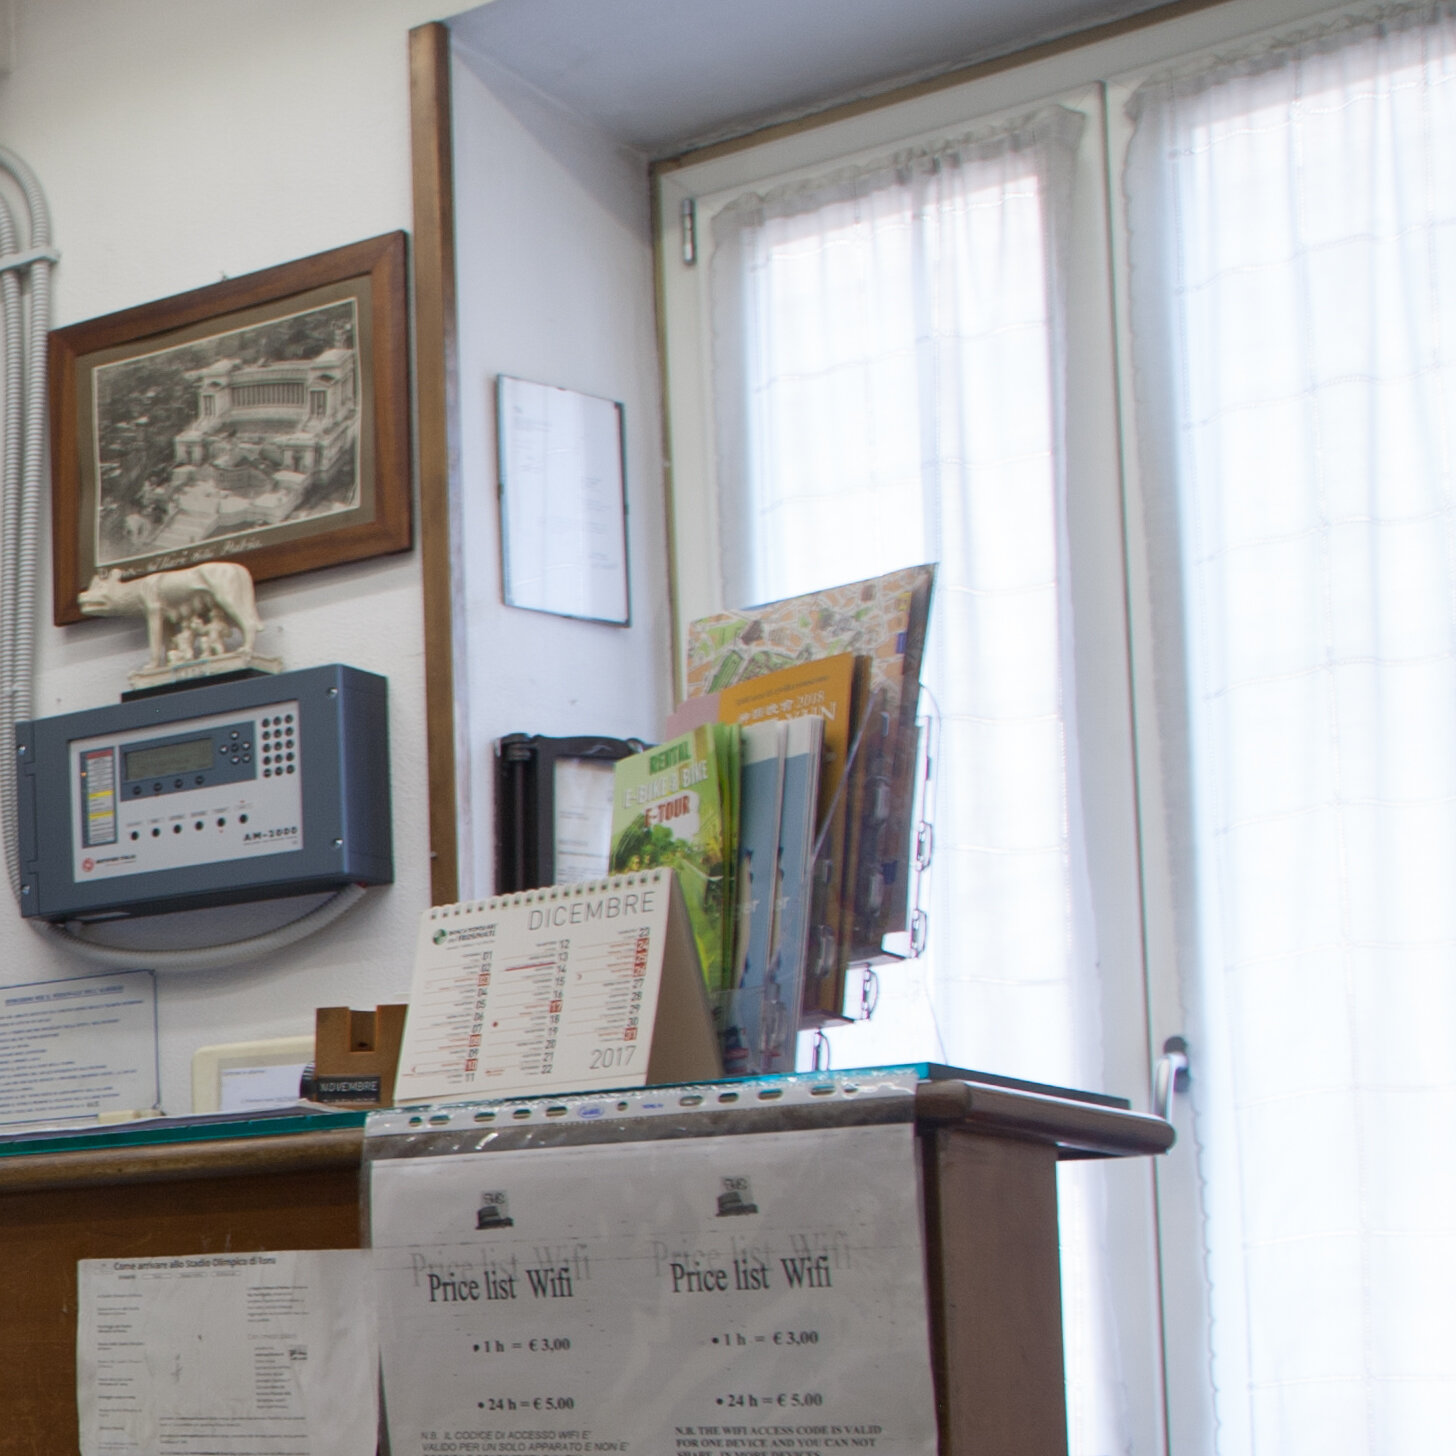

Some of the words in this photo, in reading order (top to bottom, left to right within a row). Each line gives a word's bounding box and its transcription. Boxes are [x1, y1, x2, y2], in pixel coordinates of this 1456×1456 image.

[649, 741, 692, 776] RENTAL
[680, 759, 709, 789] BIKE
[644, 795, 691, 828] E-TOUR
[528, 891, 657, 931] DICEMBRE
[589, 1045, 638, 1070] 2017
[319, 1080, 379, 1093] NOVEMBRE
[114, 1261, 137, 1271] Come
[138, 1260, 169, 1271] arrivare
[170, 1259, 185, 1269] allo
[186, 1258, 211, 1269] Stadio
[213, 1257, 248, 1271] Olimpico
[670, 1263, 728, 1293] Price
[733, 1258, 771, 1291] list
[780, 1256, 833, 1289] Wifi
[428, 1273, 480, 1302] Price
[484, 1270, 518, 1300] list
[526, 1267, 574, 1299] Wifi
[495, 1340, 505, 1352] h
[541, 1338, 571, 1352] 3,00
[736, 1333, 746, 1346] h
[786, 1331, 820, 1345] 3,00
[488, 1398, 505, 1410] 24
[508, 1398, 517, 1410] h
[545, 1397, 575, 1409] 5.00
[727, 1394, 745, 1407] 24
[749, 1394, 759, 1407] h
[791, 1393, 823, 1407] 5.00
[675, 1426, 696, 1435] N.B.
[698, 1426, 719, 1435] THE
[722, 1426, 748, 1436] WIFI
[750, 1426, 795, 1436] ACCESS
[796, 1425, 828, 1435] CODE
[831, 1425, 843, 1435] IS
[845, 1425, 883, 1435] VALID
[676, 1439, 699, 1448] FOR
[700, 1439, 723, 1448] ONE
[725, 1438, 768, 1448] DEVICE
[771, 1438, 795, 1448] AND
[797, 1438, 823, 1448] YOU
[824, 1438, 849, 1448] CAN
[851, 1438, 877, 1448] NOT
